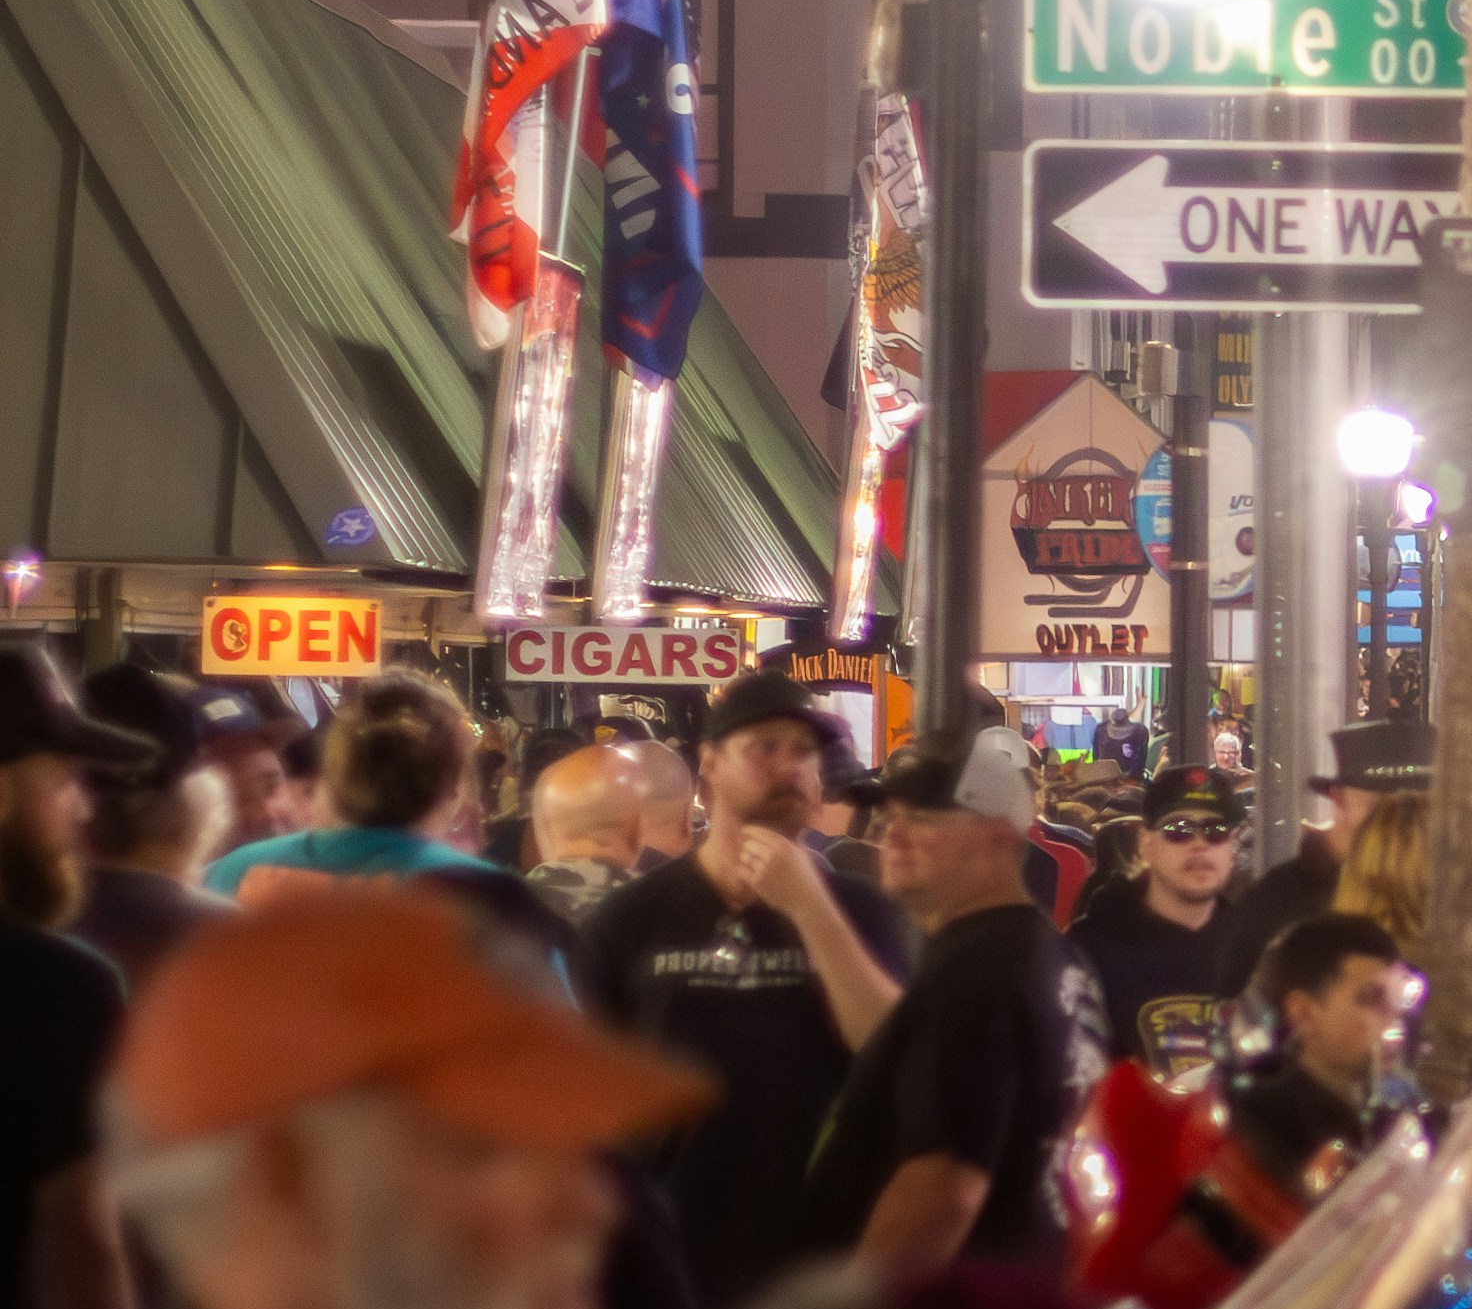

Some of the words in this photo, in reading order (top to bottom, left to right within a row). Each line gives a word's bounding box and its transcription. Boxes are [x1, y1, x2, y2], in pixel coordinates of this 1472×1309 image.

[1180, 196, 1307, 255] ONE
[211, 607, 376, 663] OPEN
[507, 630, 738, 679] CIGARS
[1036, 624, 1149, 657] OUTLET
[788, 653, 824, 682] JACK
